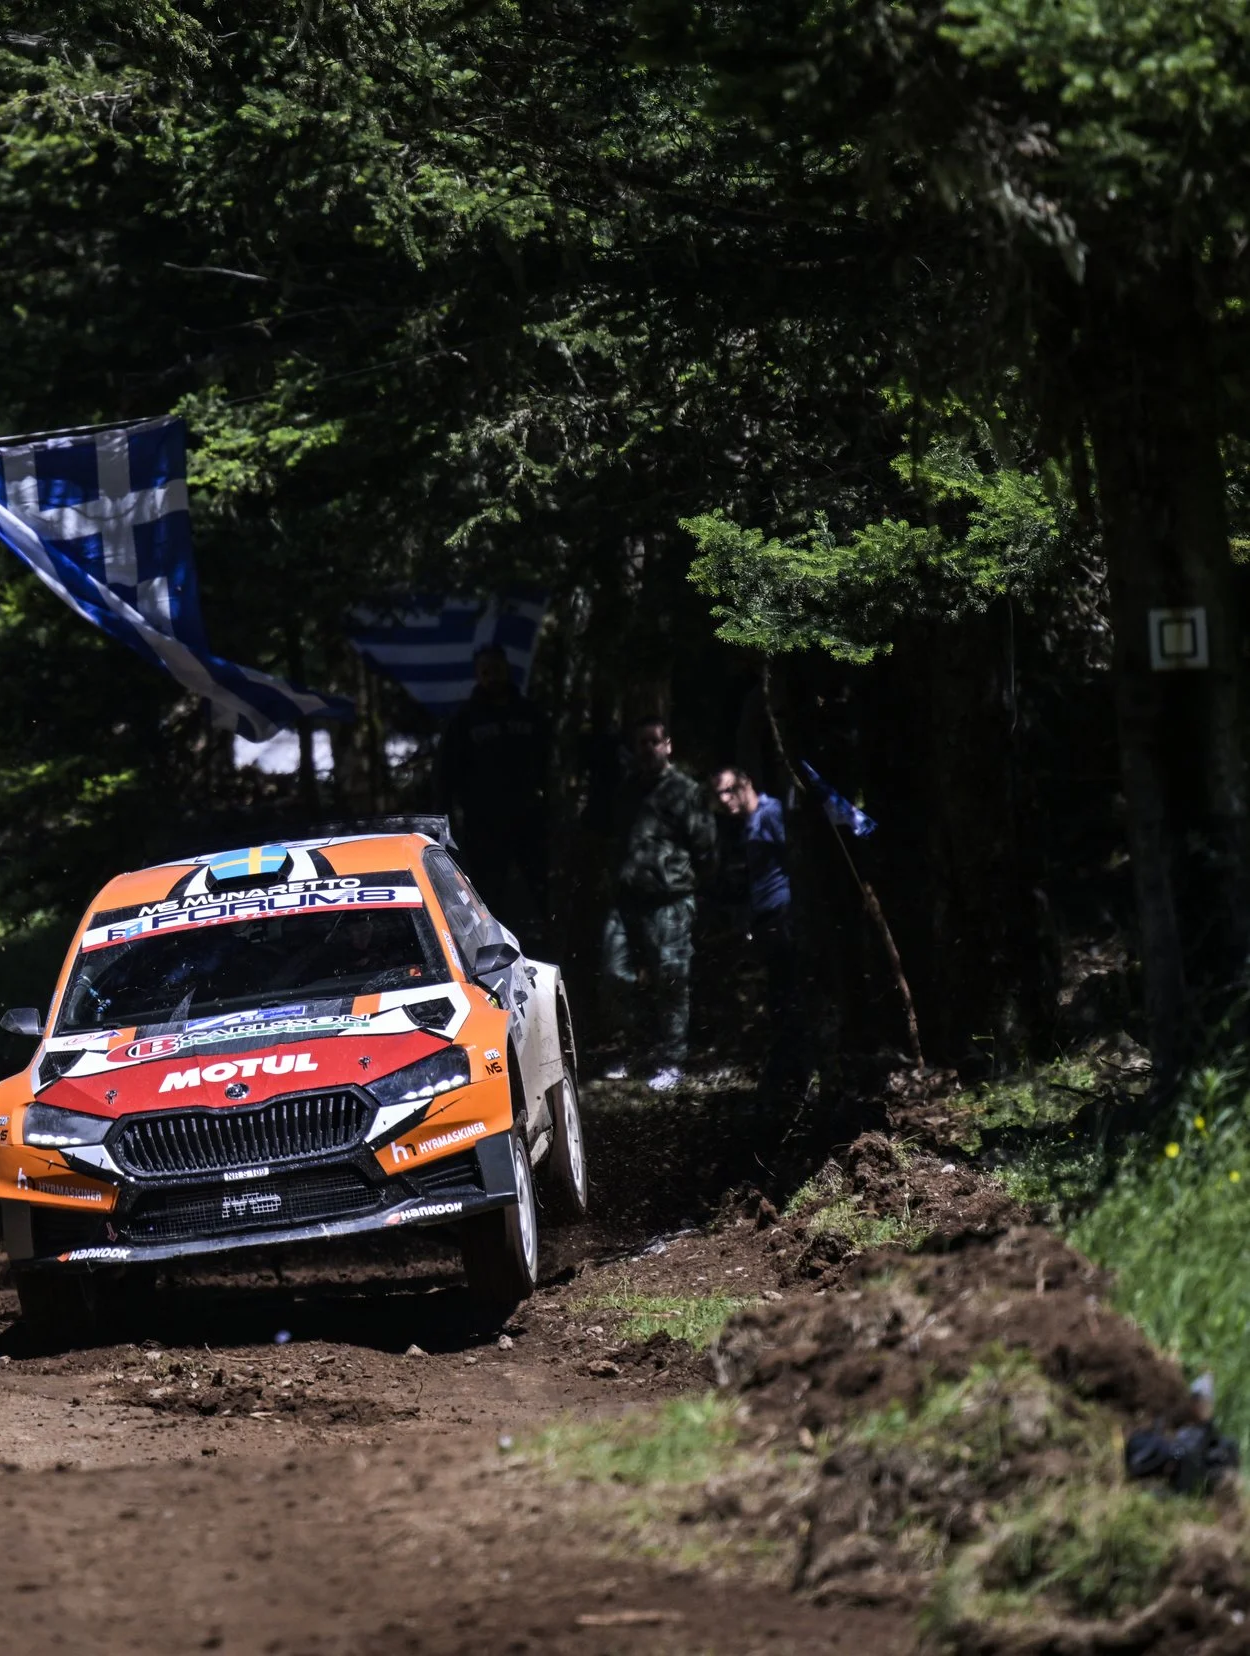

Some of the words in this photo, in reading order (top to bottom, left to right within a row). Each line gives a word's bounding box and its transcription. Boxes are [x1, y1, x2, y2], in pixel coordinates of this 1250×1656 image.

[138, 900, 179, 918] MS
[183, 878, 361, 909] MUNARETTO
[152, 888, 396, 930] FORUM8
[180, 1013, 371, 1042] CARLSSON
[158, 1053, 318, 1093] MOTUL
[485, 1061, 503, 1076] MS
[418, 1121, 487, 1154] HYRMASKINER
[38, 1181, 102, 1202] HYRMASKINER
